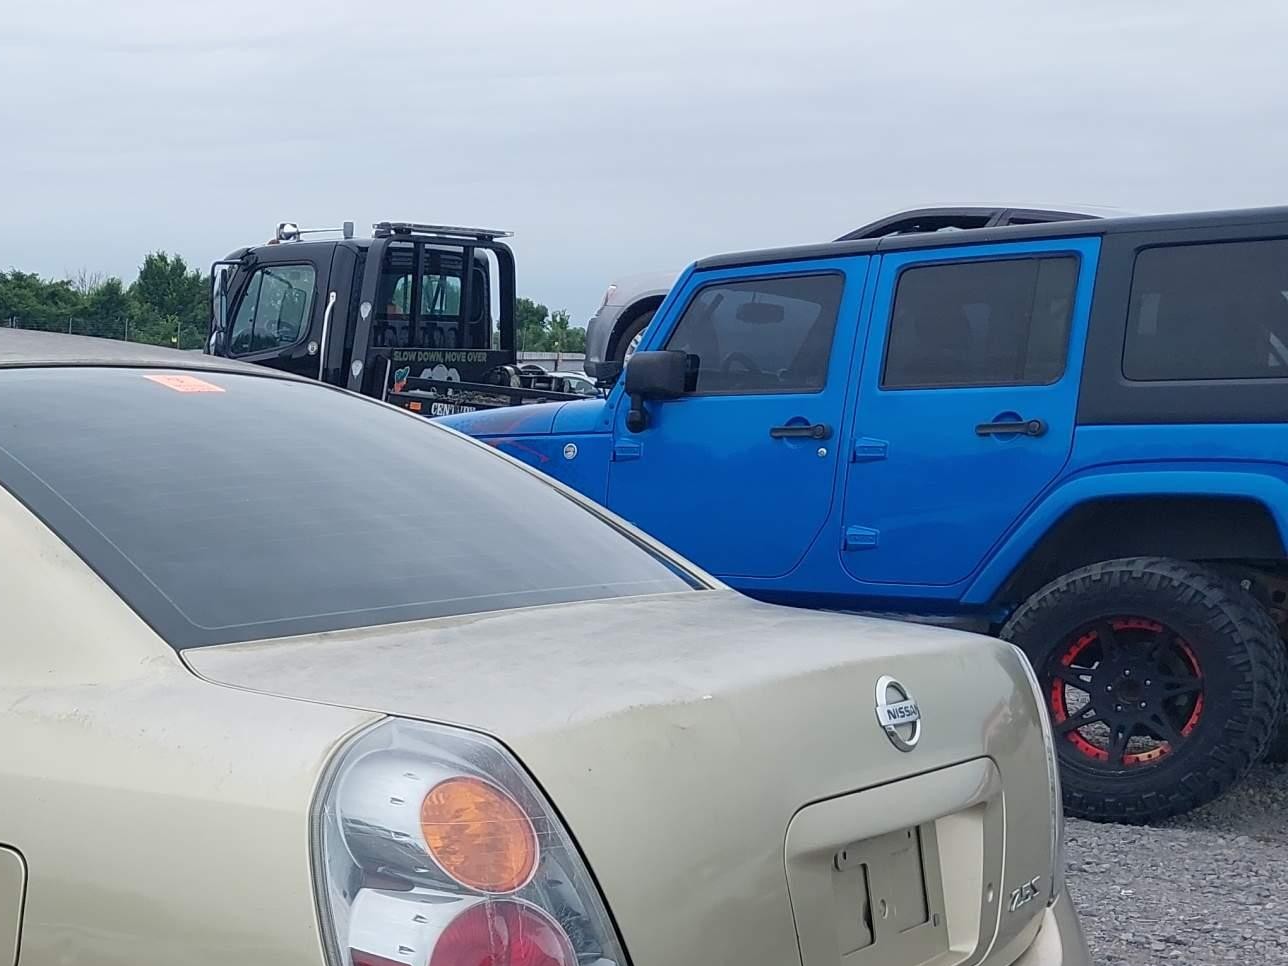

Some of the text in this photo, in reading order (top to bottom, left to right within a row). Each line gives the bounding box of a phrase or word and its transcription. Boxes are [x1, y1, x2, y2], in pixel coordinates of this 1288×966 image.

[393, 351, 487, 363] SLOW DOWN, MOVE OVER
